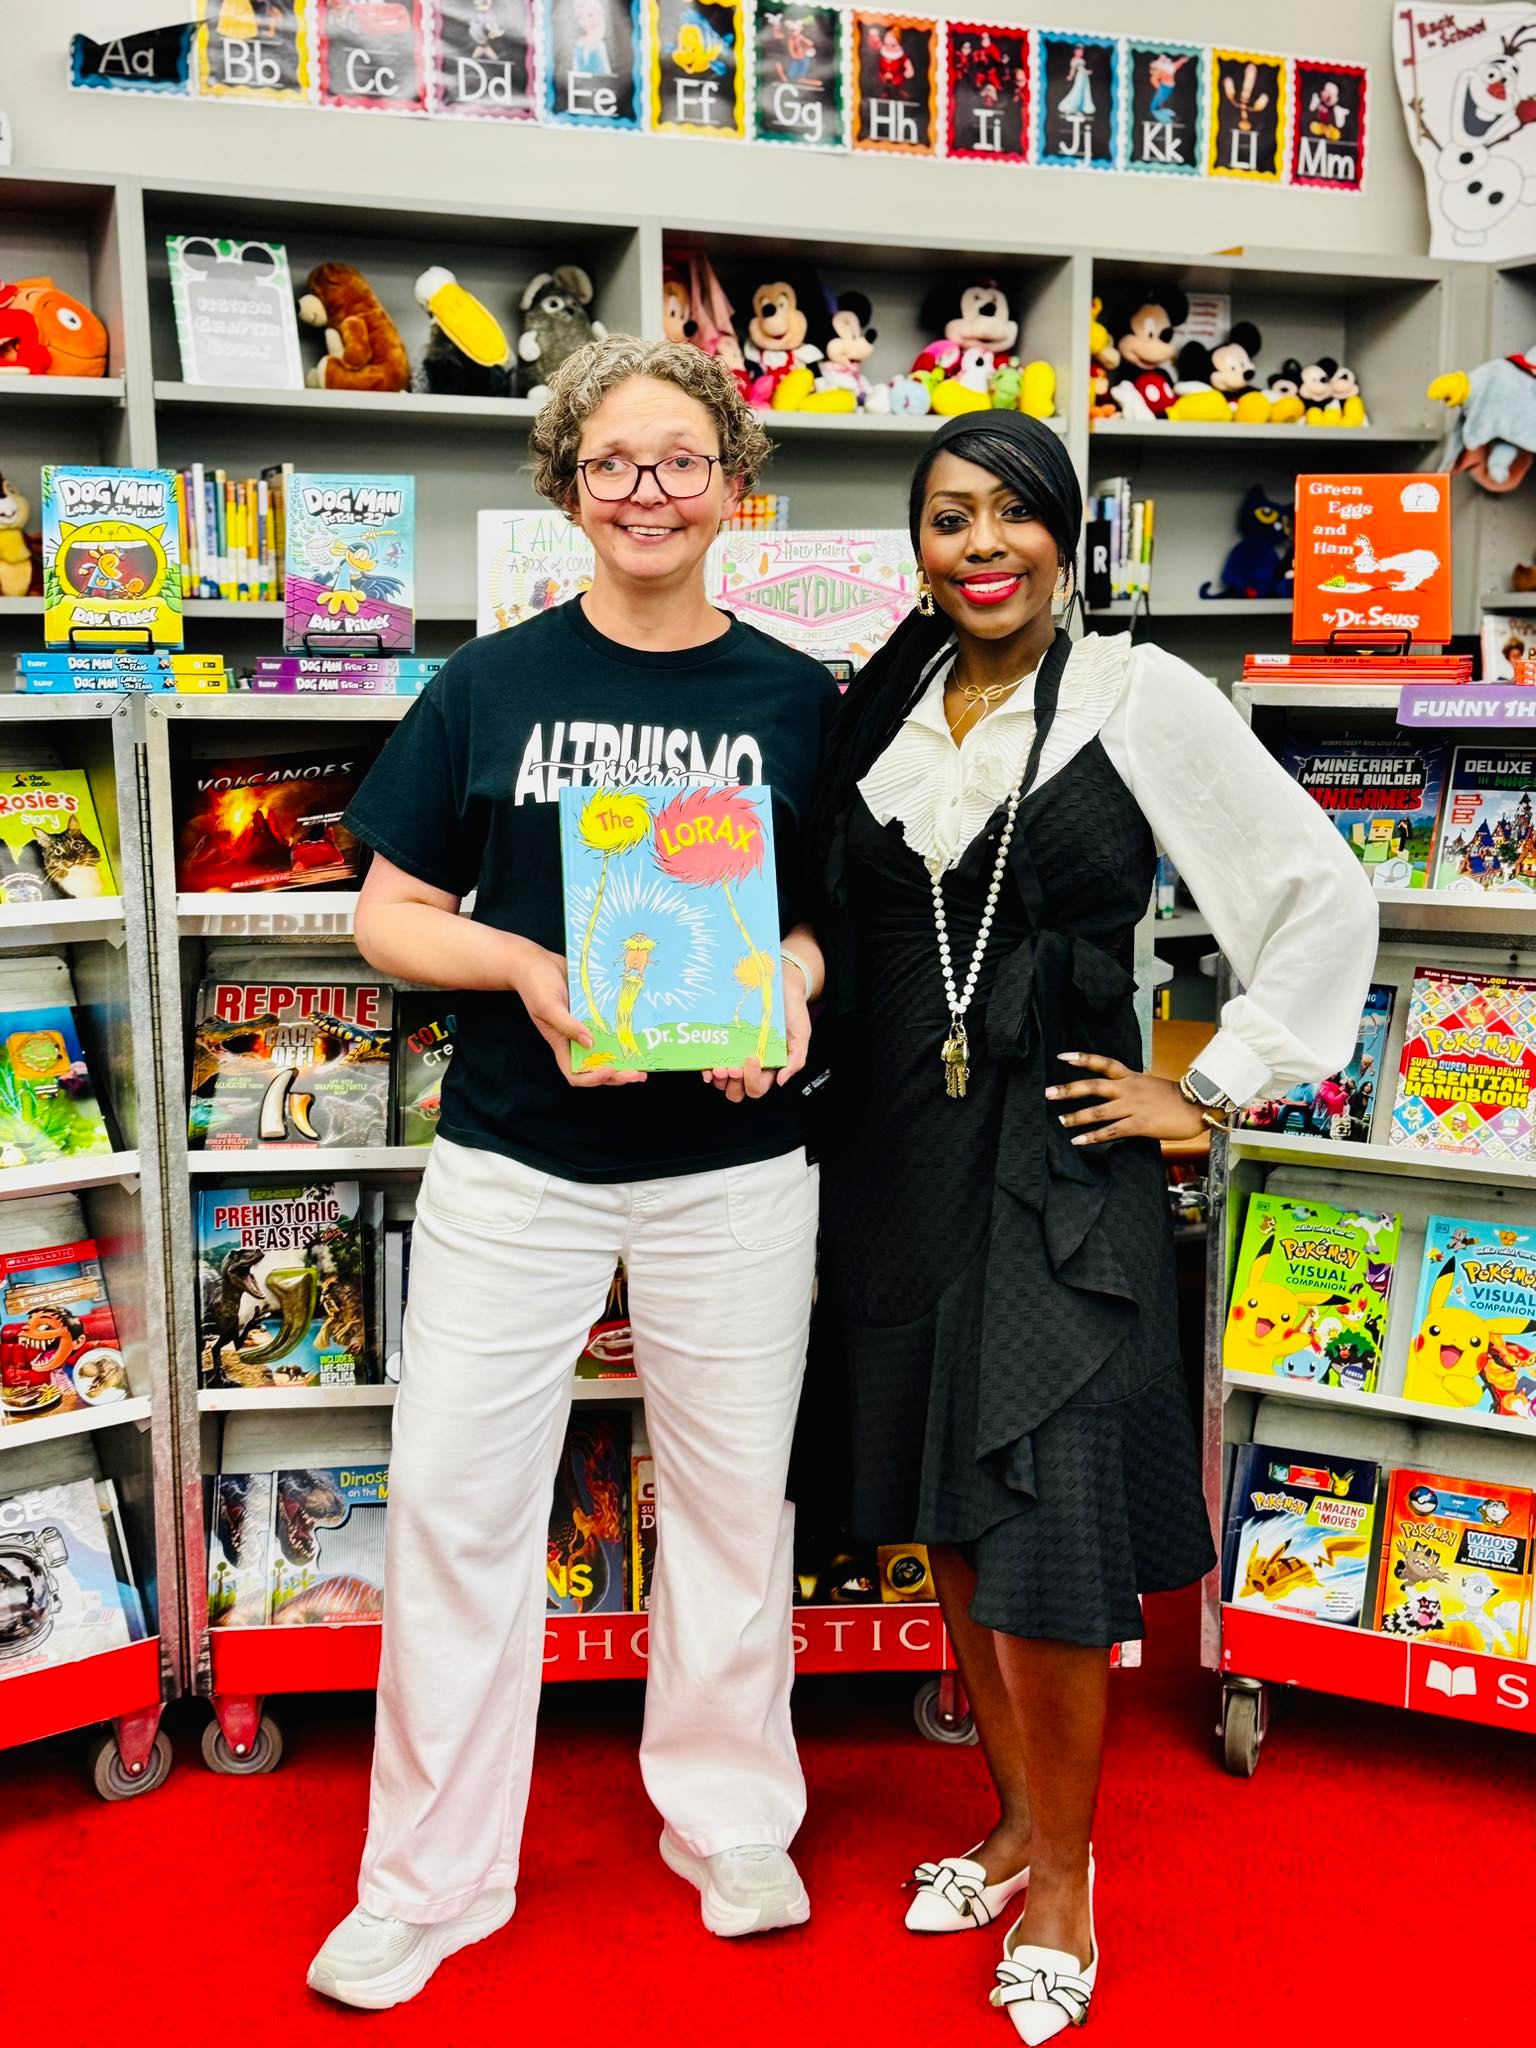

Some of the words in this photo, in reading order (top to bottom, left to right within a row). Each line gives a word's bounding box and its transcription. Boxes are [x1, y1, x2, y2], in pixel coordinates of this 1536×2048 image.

[99, 40, 155, 77] Aa
[222, 38, 281, 85] Bb
[346, 48, 399, 97] Cc
[457, 57, 513, 102] Dd
[567, 71, 619, 117] Ee
[675, 79, 719, 122] Ff
[773, 83, 824, 142] Gg
[870, 98, 918, 143] Hh
[973, 108, 1001, 151] Ii
[1059, 114, 1093, 167] Jj
[1142, 121, 1184, 164] Kk
[1230, 130, 1257, 169] Ll
[1298, 137, 1355, 180] Mm
[58, 479, 111, 505] DOG
[114, 480, 164, 507] MAN
[302, 487, 351, 513] DOG
[354, 488, 402, 515] MAN
[1309, 482, 1363, 496] Green
[1328, 500, 1373, 519] Eggs
[530, 518, 574, 553] AM
[1313, 523, 1347, 535] and
[782, 542, 811, 559] Harry
[815, 543, 849, 559] Potter
[1093, 545, 1108, 574] R
[1313, 542, 1354, 555] Ham
[745, 575, 886, 618] HONEYDUKES
[70, 606, 107, 626] DAV
[307, 614, 341, 632] DAV
[1336, 607, 1367, 628] Dr.
[1368, 606, 1420, 628] Seuss
[67, 656, 91, 670] DOG
[92, 657, 114, 671] MAN
[299, 659, 322, 673] DOG
[323, 659, 342, 673] MAN
[73, 676, 96, 689] DOG
[97, 677, 118, 690] MAN
[296, 678, 318, 691] DOG
[319, 678, 340, 691] MAN
[1412, 700, 1501, 717] FUNNY
[197, 762, 354, 792] VOLCANOES
[1312, 758, 1416, 773] MINECRAFT
[1464, 759, 1532, 775] DELUXE
[1302, 773, 1360, 785] MASTER
[1362, 773, 1422, 786] BUILDER
[1307, 787, 1424, 811] INIGAMES
[21, 814, 60, 829] Story
[596, 808, 635, 832] The
[659, 814, 758, 857] LORAX
[1482, 977, 1508, 985] 1,000
[215, 984, 380, 1028] REPTILE
[265, 1025, 316, 1047] FACE
[641, 1026, 674, 1050] Dr.
[677, 1022, 729, 1045] Seuss
[1421, 1025, 1525, 1063] Pokémon
[1407, 1066, 1530, 1093] ESSENTIAL
[1410, 1057, 1438, 1070] SUPER
[1439, 1060, 1467, 1073] DUPER
[1468, 1063, 1496, 1075] EXTRA
[1497, 1067, 1531, 1079] DELUXE
[1404, 1081, 1529, 1109] HANDBOOK
[214, 1200, 341, 1229] PREHISTORIC
[241, 1225, 315, 1249] BEASTS
[16, 1250, 72, 1265] SCHOLASTIC
[1280, 1238, 1360, 1269] Pokémon
[1286, 1276, 1346, 1292] COMPANION
[1289, 1263, 1348, 1282] VISUAL
[1472, 1286, 1536, 1306] VISUAL
[1470, 1300, 1536, 1317] COMPANION
[320, 1371, 356, 1383] REPLICA
[362, 1488, 377, 1497] the
[1251, 1492, 1308, 1516] Pokémon
[1314, 1503, 1366, 1519] AMAZING
[1320, 1514, 1358, 1530] MOVES
[1401, 1522, 1458, 1547] Pokémon
[1467, 1531, 1519, 1550] WHO'S
[1468, 1546, 1515, 1566] THAT?
